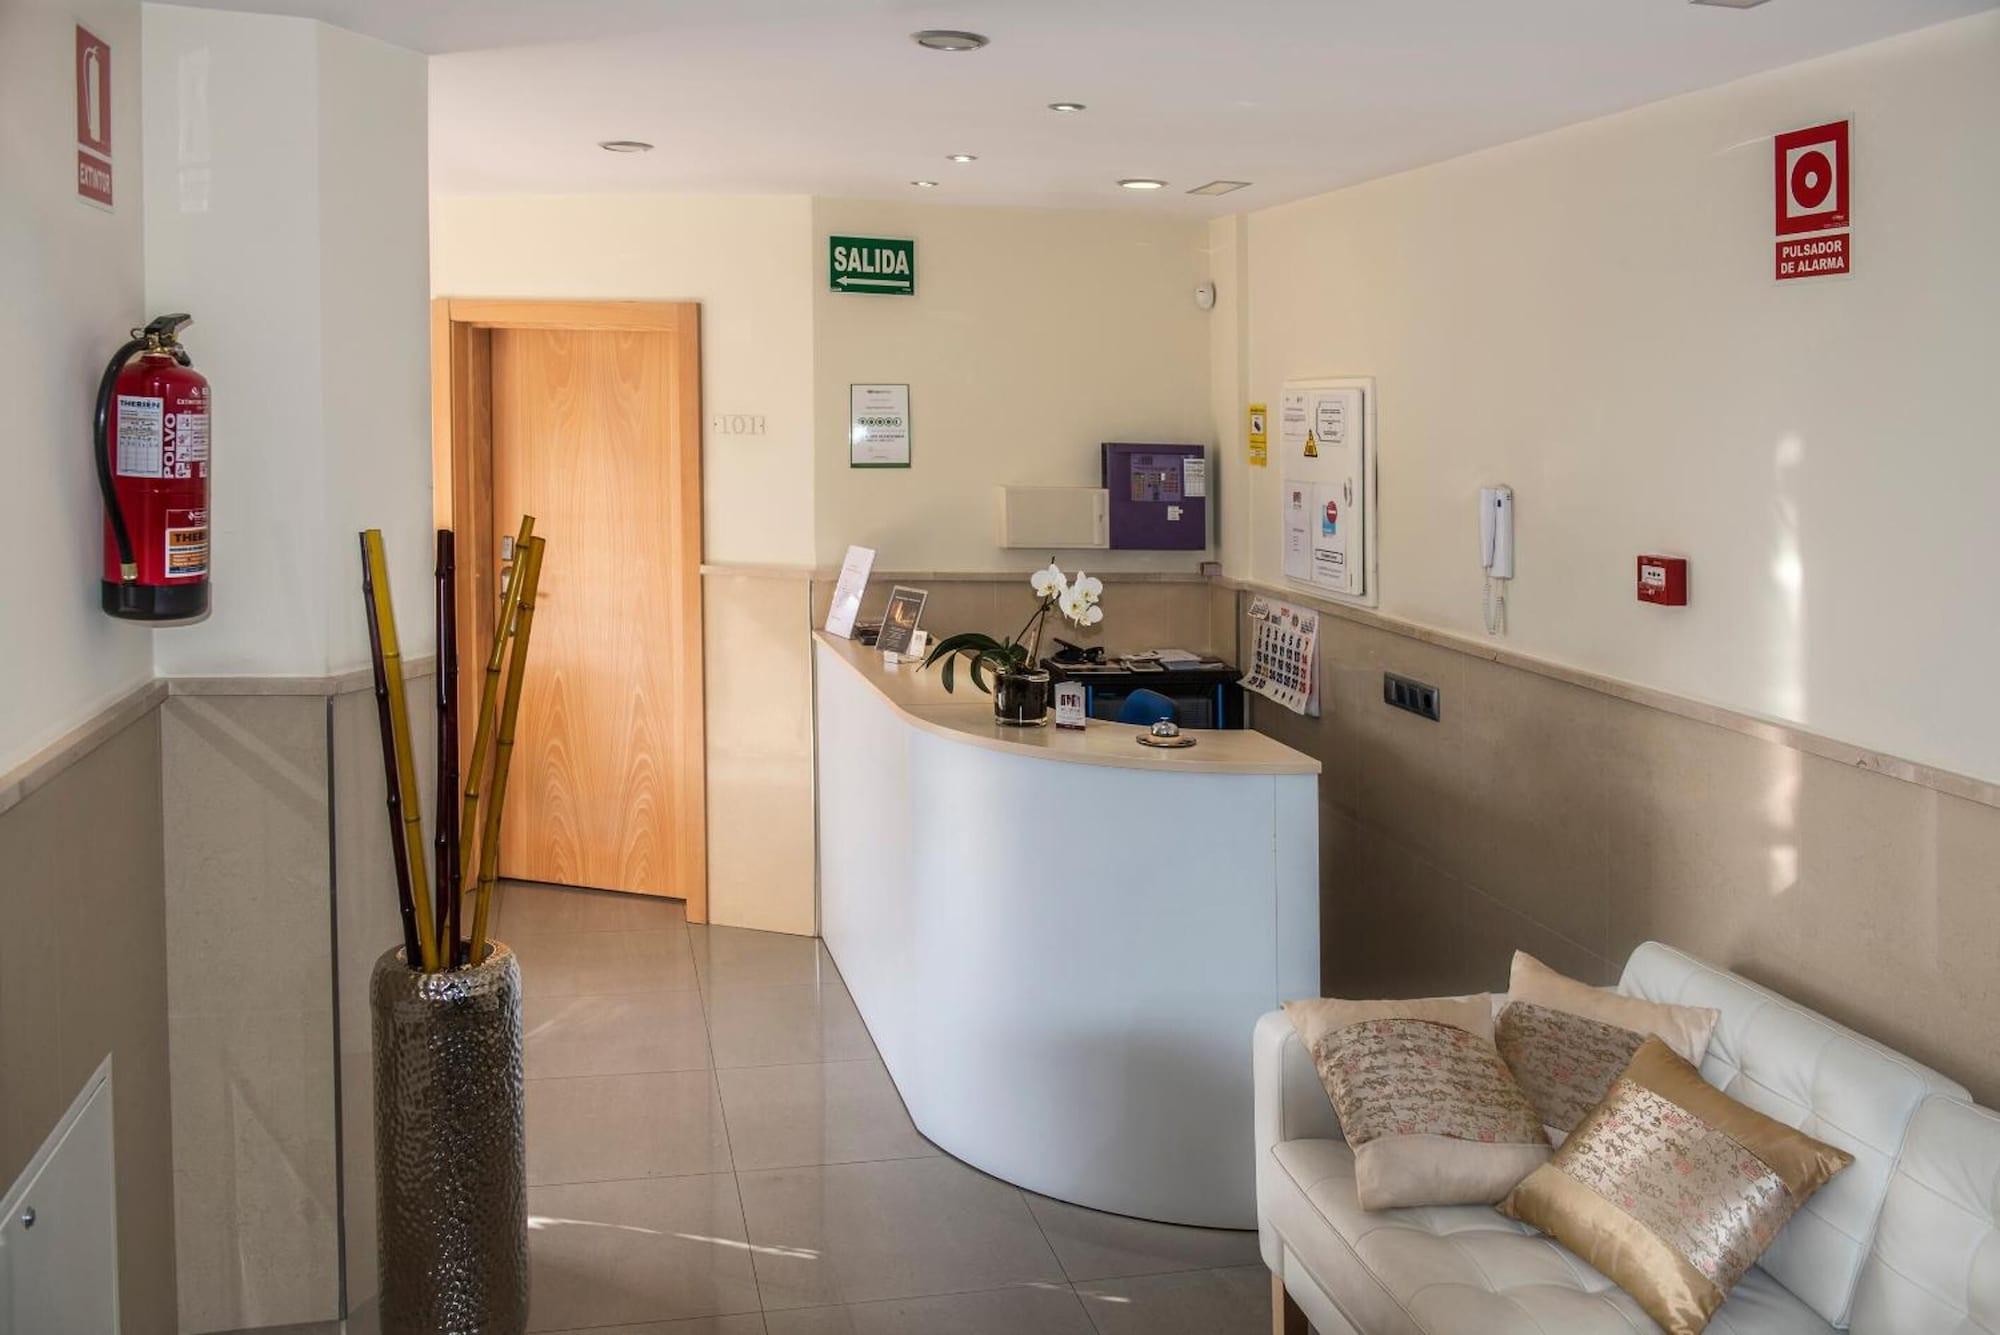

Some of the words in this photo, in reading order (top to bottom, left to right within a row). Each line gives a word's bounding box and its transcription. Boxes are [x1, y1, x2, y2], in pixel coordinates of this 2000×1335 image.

[80, 162, 110, 194] EXTINTOR
[834, 246, 910, 274] SALIDA
[1782, 240, 1842, 258] PULSADOR
[1781, 262, 1795, 274] DE
[1798, 256, 1844, 272] ALARMA
[164, 413, 176, 478] POLVO
